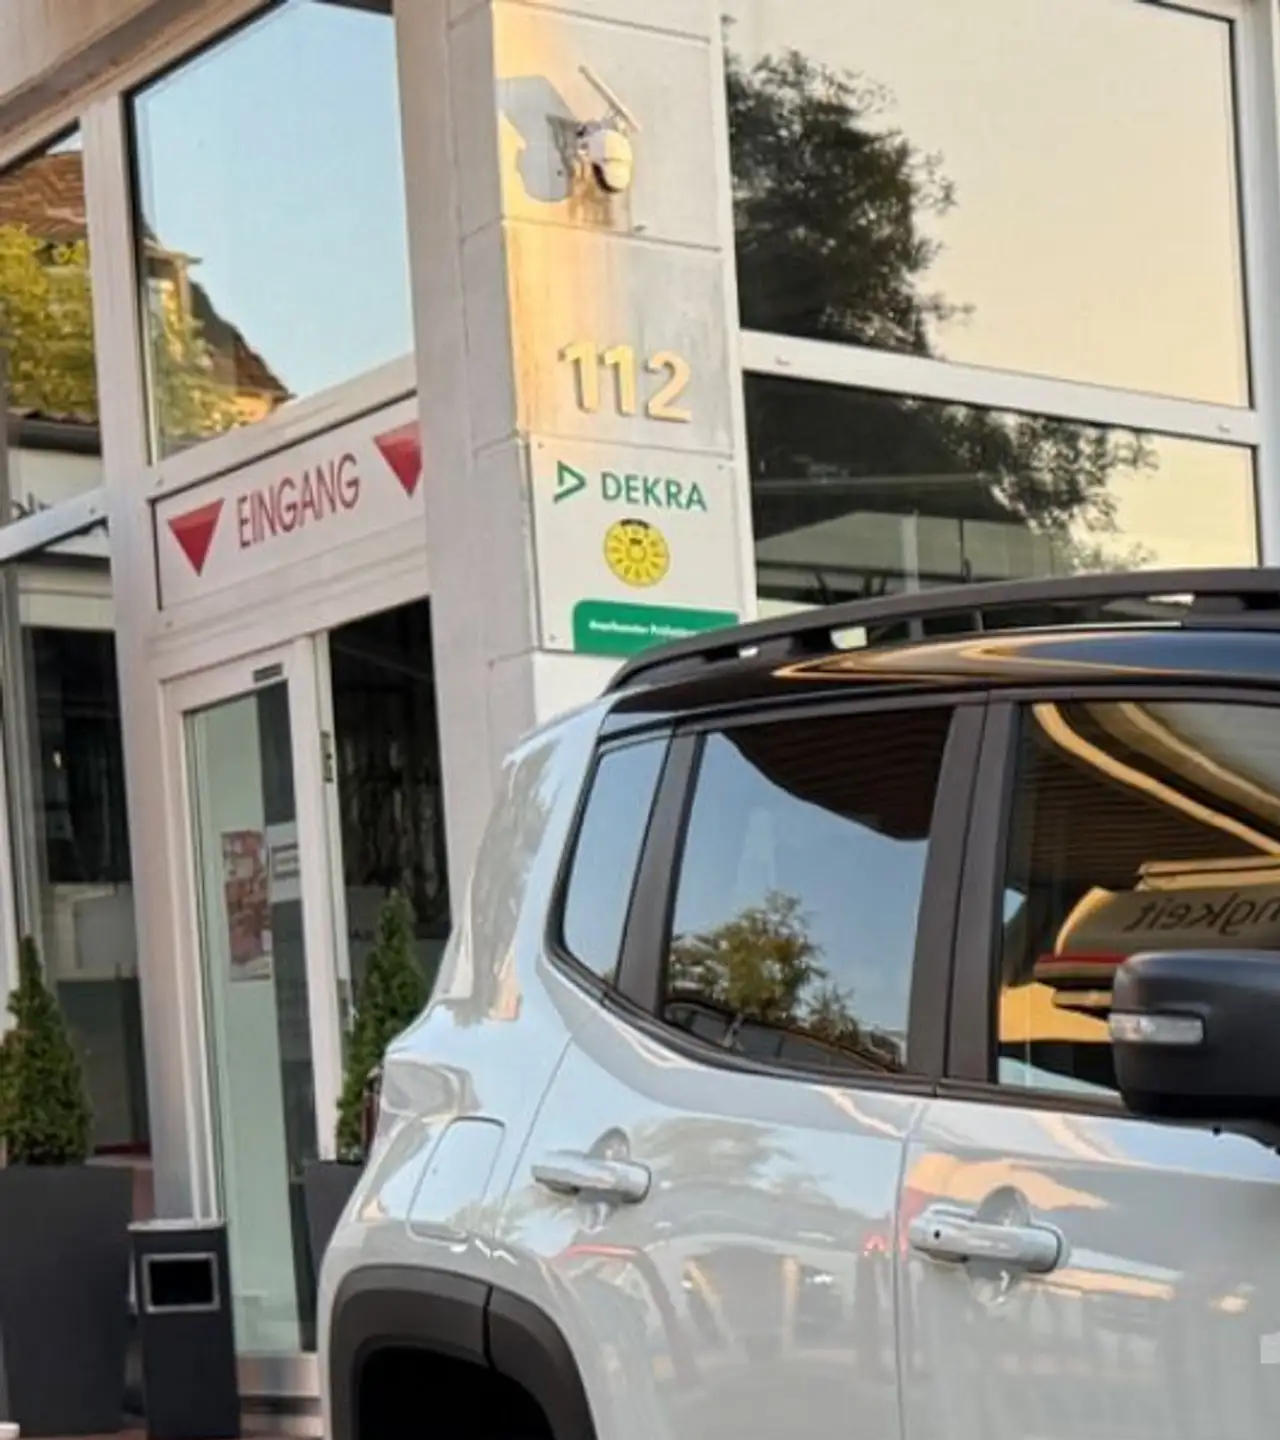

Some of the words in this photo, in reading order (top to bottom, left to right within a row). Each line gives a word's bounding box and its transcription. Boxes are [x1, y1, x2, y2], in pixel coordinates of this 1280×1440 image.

[559, 342, 692, 423] 112
[237, 452, 361, 549] EINGANG
[601, 470, 708, 513] DEKRA
